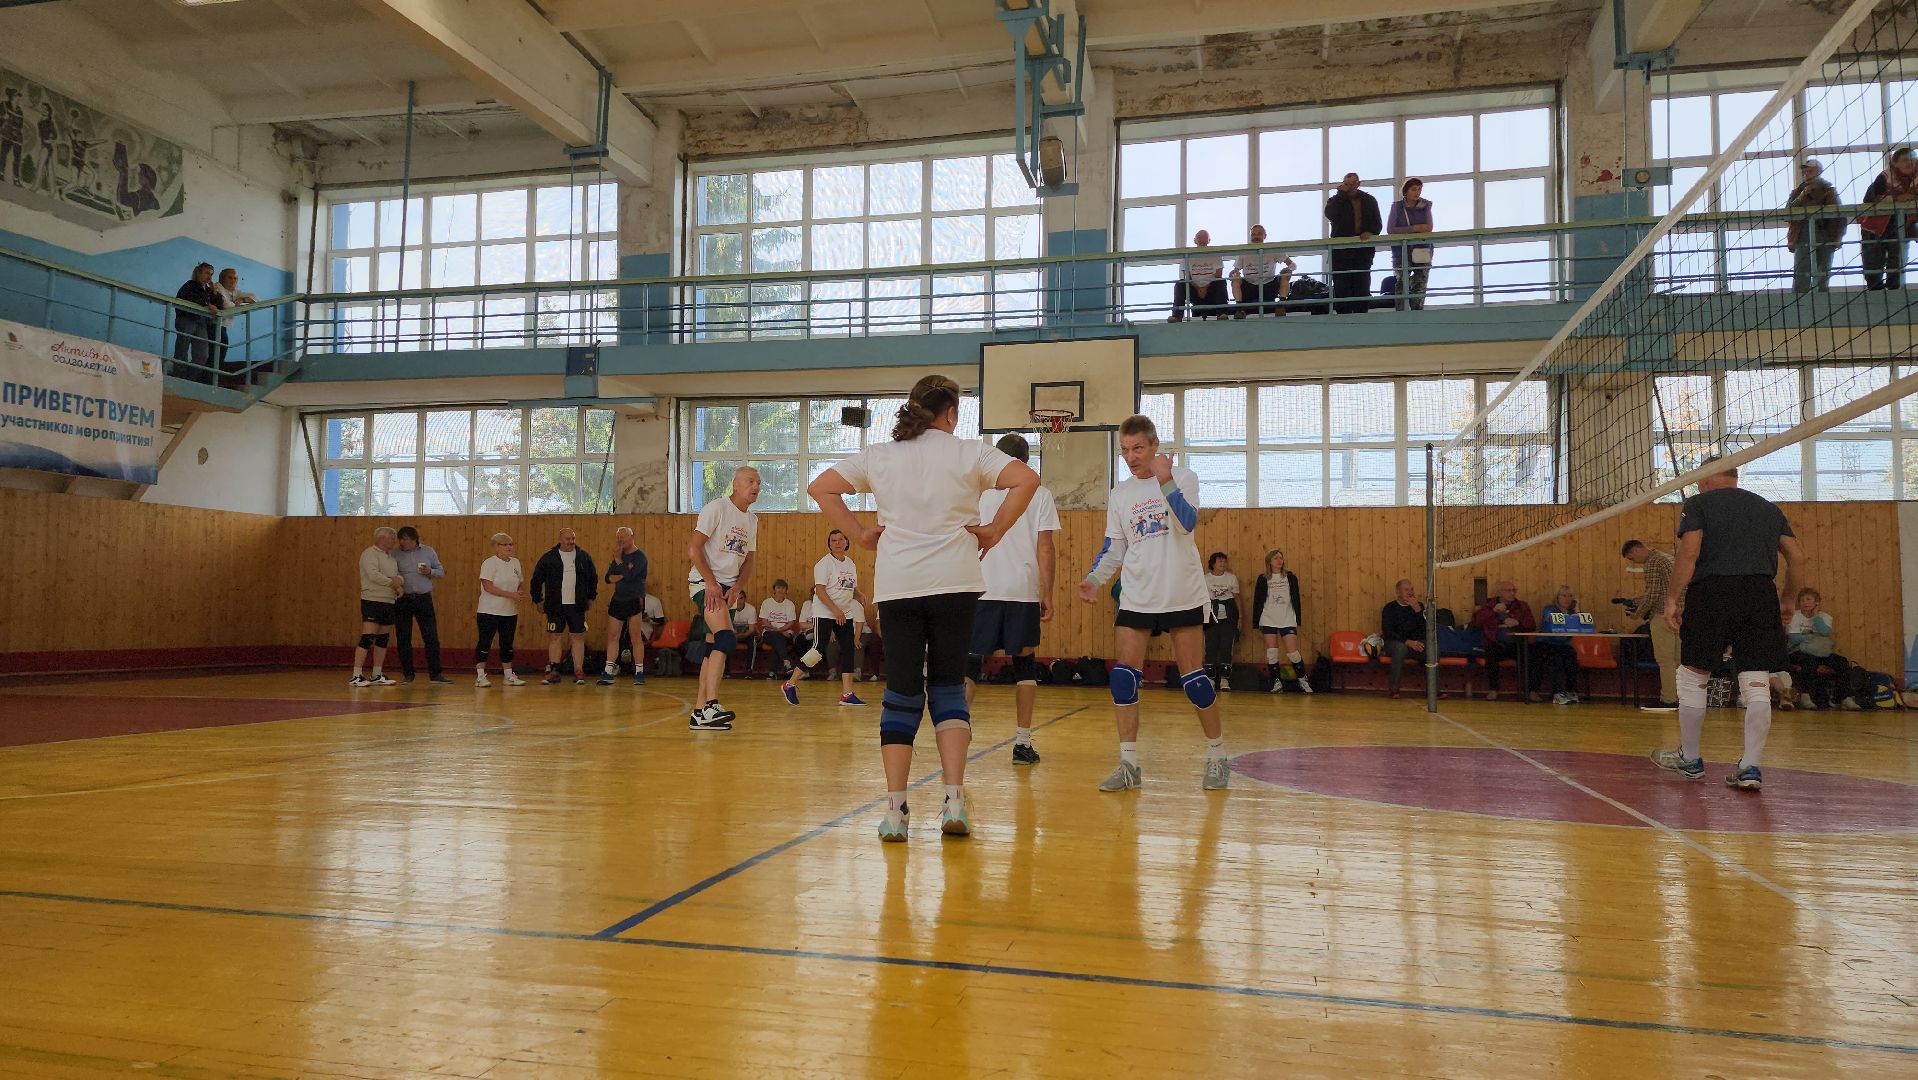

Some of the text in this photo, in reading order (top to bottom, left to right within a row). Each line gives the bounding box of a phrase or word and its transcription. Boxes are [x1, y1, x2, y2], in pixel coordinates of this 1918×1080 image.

[50, 340, 116, 363] Активно
[3, 381, 155, 428] ПРИВЕТСТВУЕМ
[1, 413, 153, 448] участников мероприятия!
[547, 621, 556, 631] 10
[1552, 613, 1565, 623] 18
[1580, 613, 1593, 623] 16
